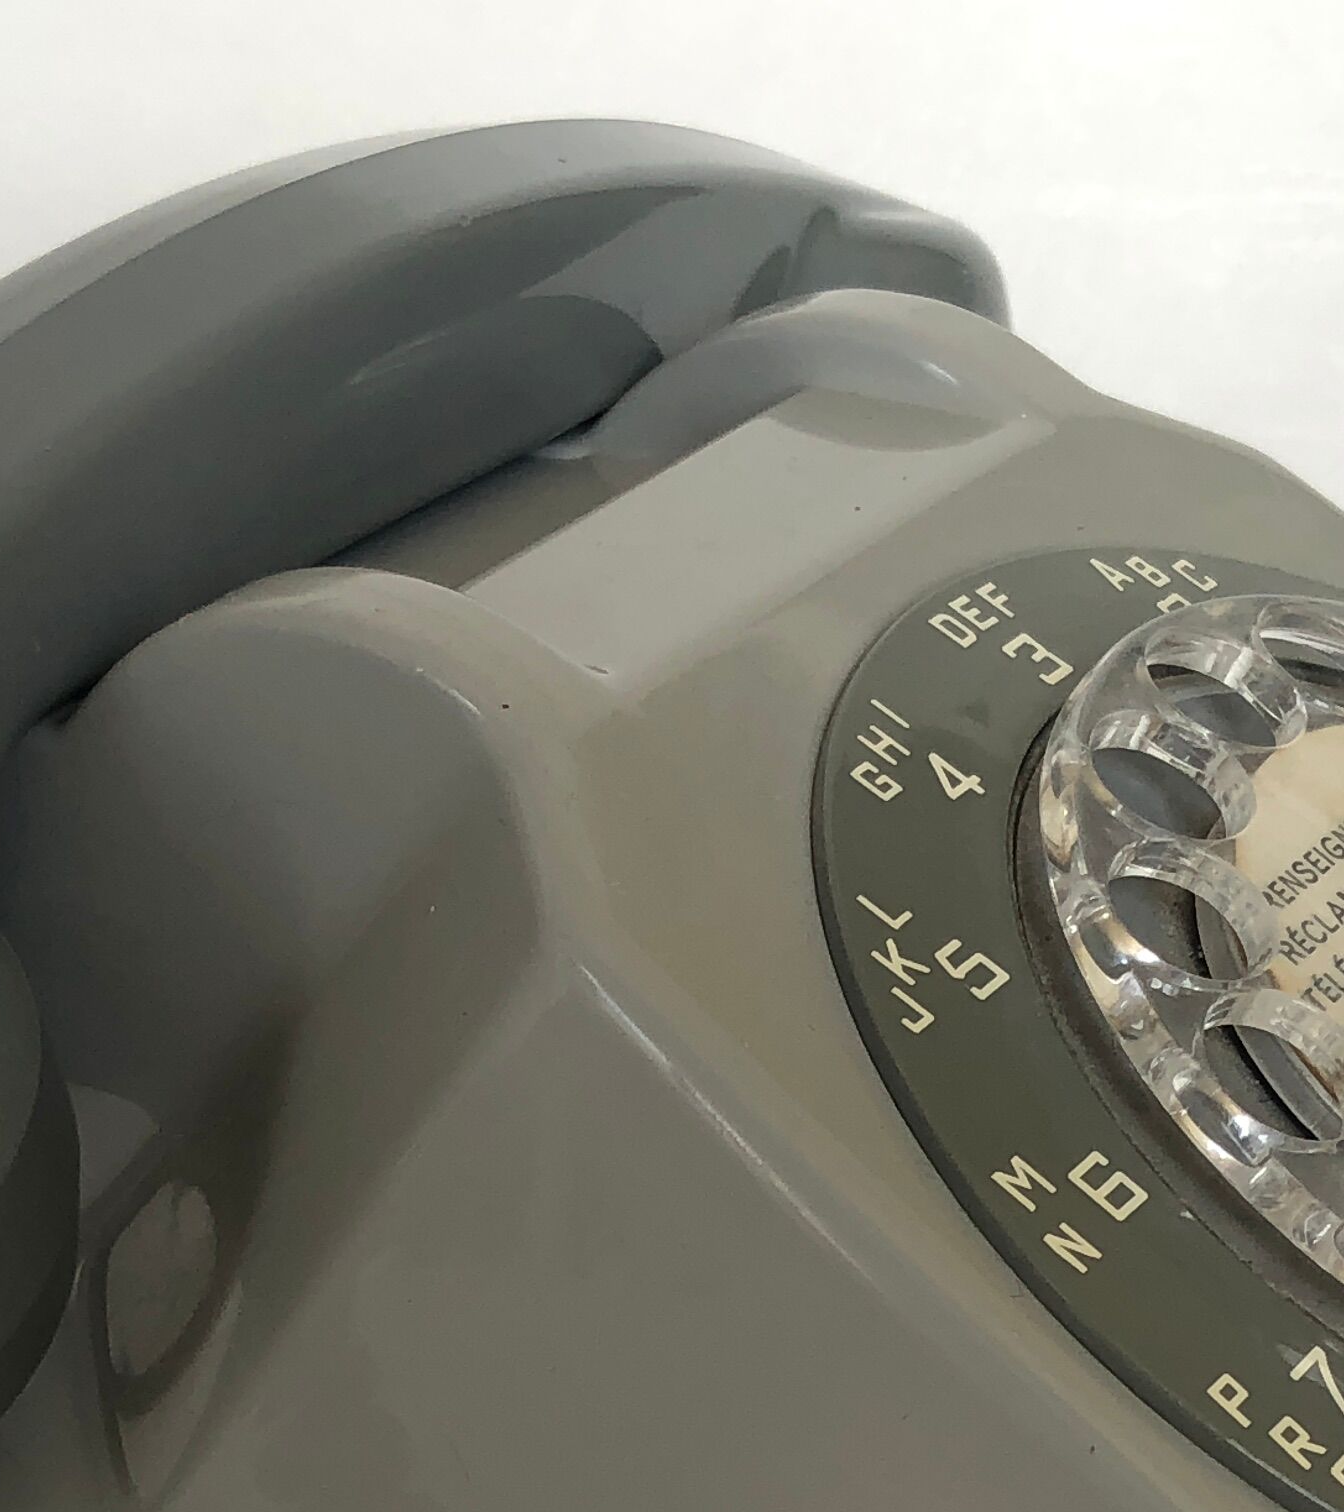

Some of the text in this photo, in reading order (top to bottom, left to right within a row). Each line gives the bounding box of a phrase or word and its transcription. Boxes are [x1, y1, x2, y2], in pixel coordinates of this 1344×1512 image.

[928, 582, 1015, 648] DEF
[1002, 632, 1074, 685] 3
[849, 698, 911, 801] GHI
[928, 752, 986, 800] 4
[934, 938, 1011, 1000] 5
[1067, 1150, 1149, 1222] 6
